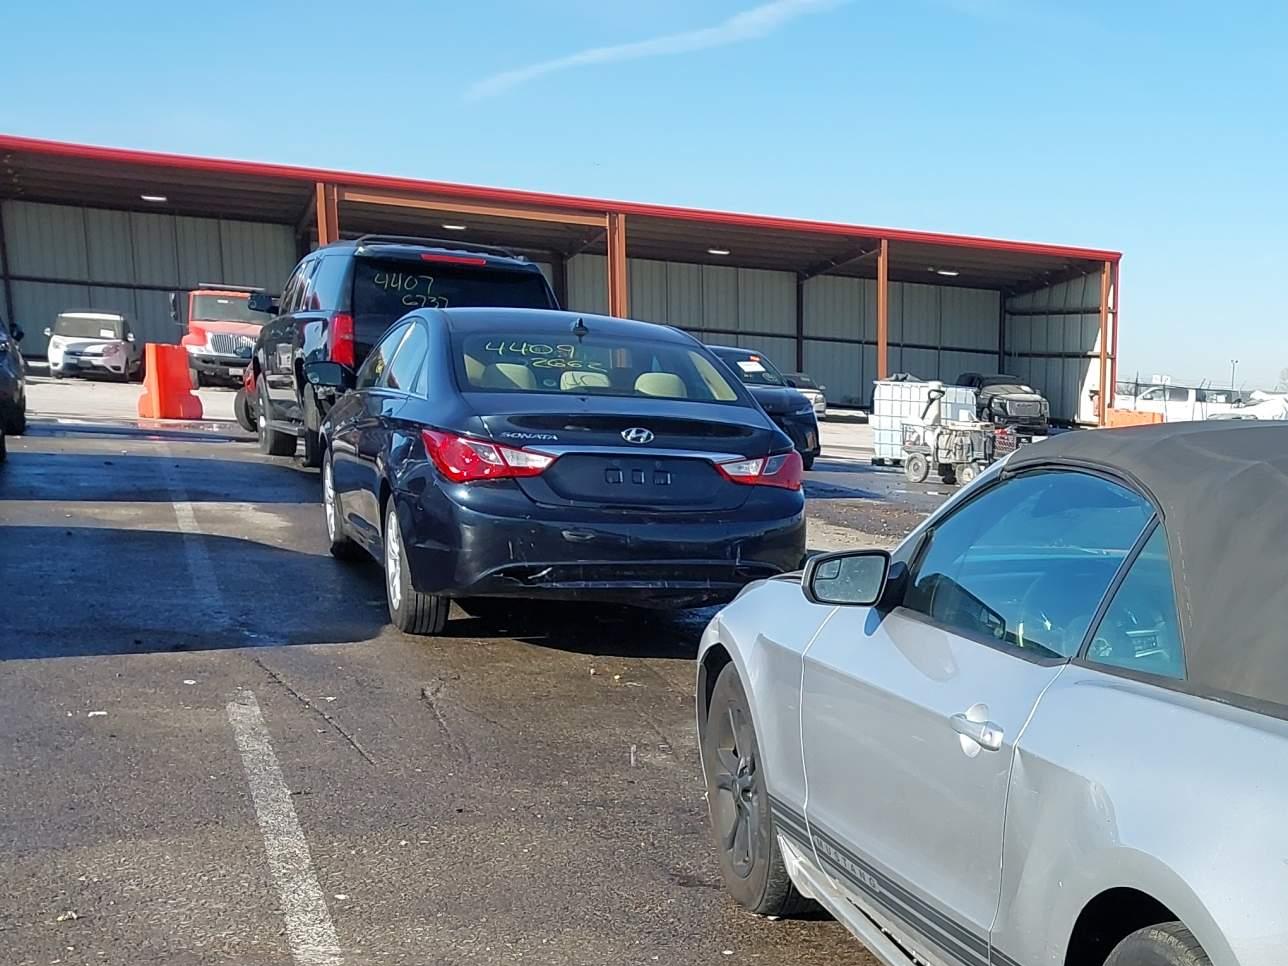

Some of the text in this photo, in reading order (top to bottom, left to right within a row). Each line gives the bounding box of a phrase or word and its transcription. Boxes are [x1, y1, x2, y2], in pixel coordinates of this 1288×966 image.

[374, 272, 434, 294] 4407
[485, 341, 575, 358] 4409
[499, 432, 559, 441] SONATA
[815, 837, 877, 888] MUSTANG
